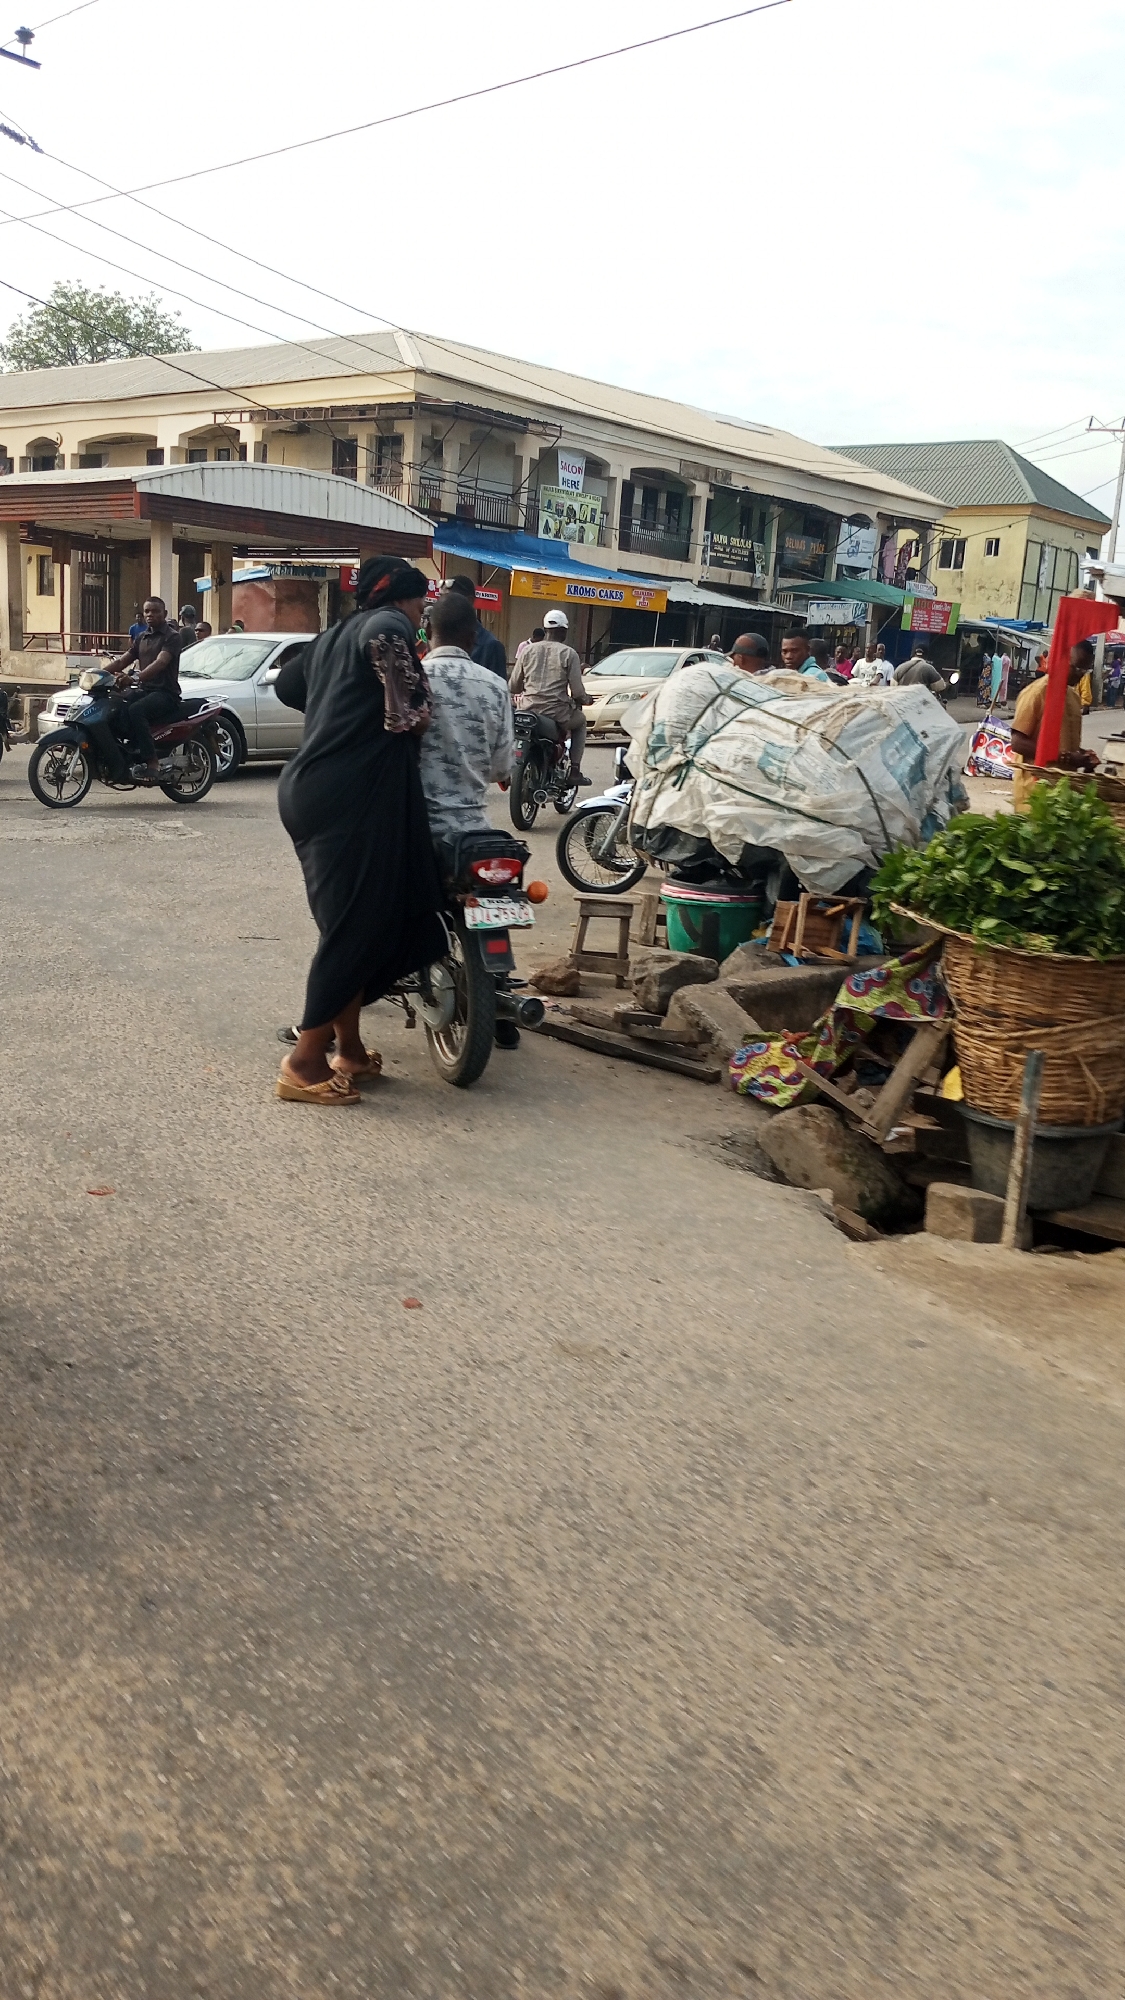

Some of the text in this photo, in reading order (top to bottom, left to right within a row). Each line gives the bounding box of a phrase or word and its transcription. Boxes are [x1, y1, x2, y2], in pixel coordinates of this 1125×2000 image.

[560, 460, 584, 476] SALON
[561, 477, 580, 491] HERE
[567, 584, 596, 598] KROMS
[598, 589, 624, 601] CAKES
